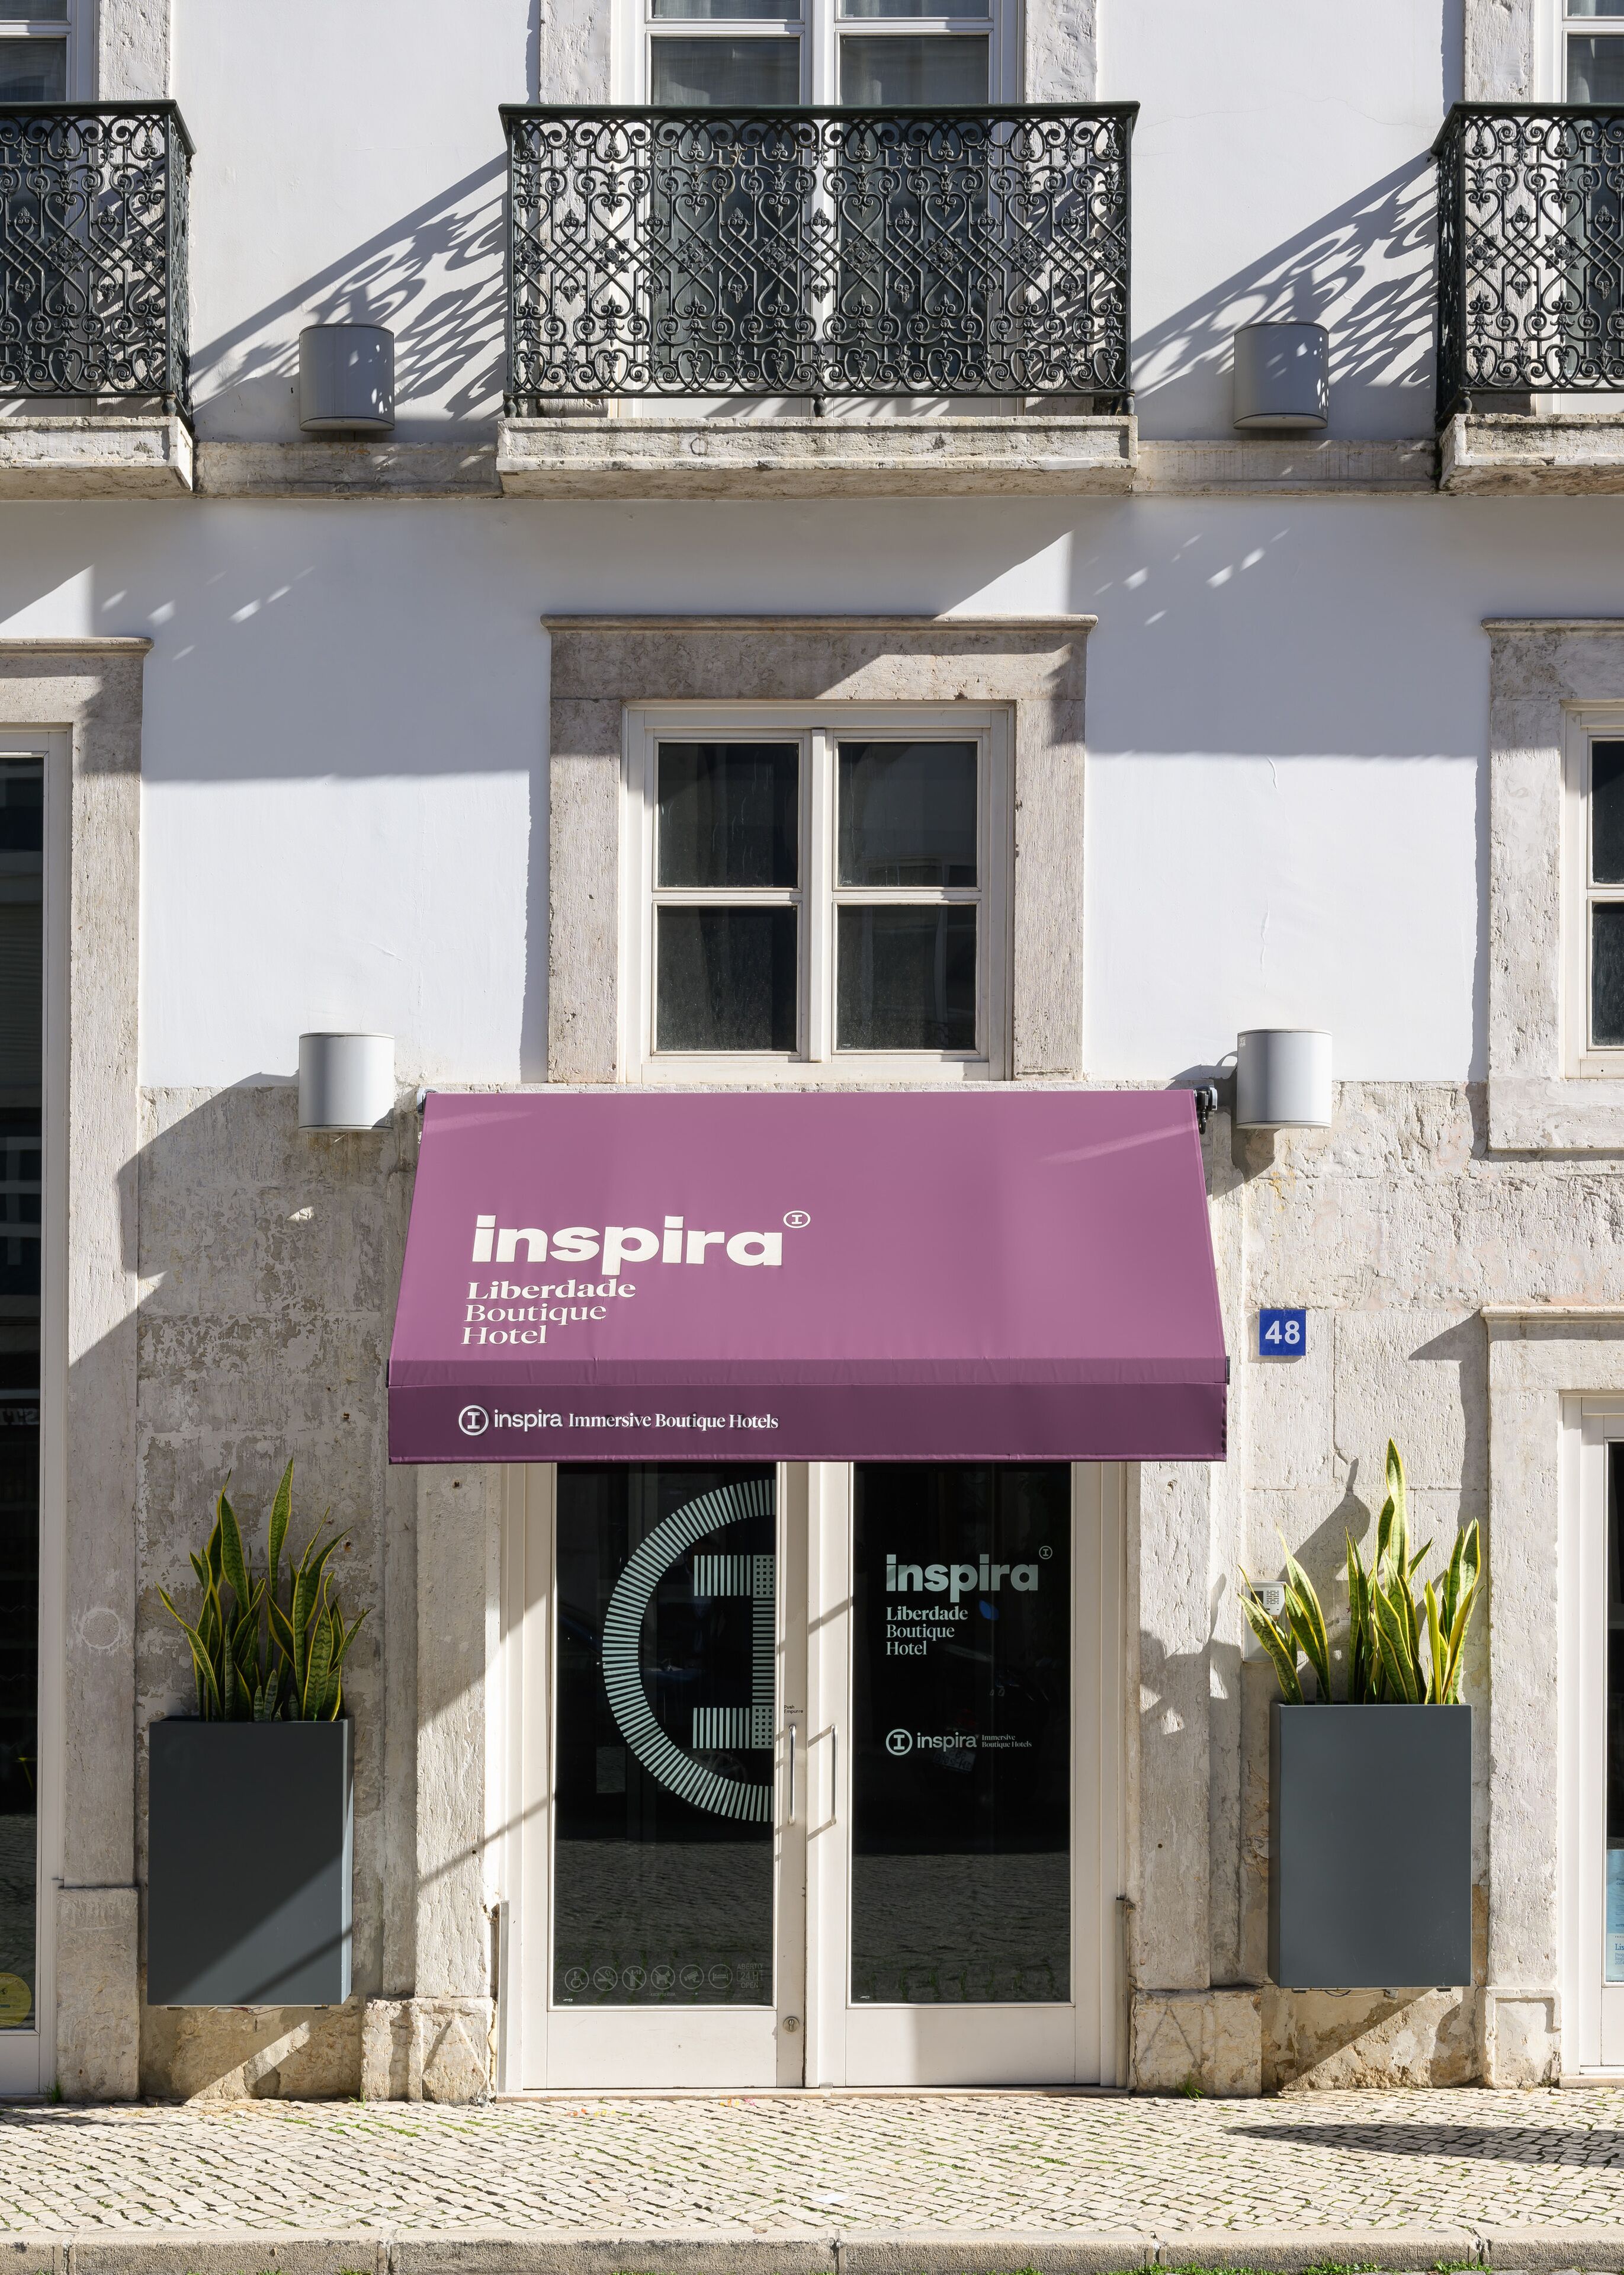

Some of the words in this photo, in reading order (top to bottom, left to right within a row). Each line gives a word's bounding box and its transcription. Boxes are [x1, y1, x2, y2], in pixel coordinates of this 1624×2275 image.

[472, 1215, 782, 1275] inspira
[466, 1279, 636, 1299] Liberdade
[464, 1303, 606, 1325] Boutique
[461, 1325, 547, 1344] Hotel
[1265, 1320, 1300, 1344] 48
[494, 1409, 563, 1431] inspira
[569, 1412, 651, 1428] Immersive
[654, 1413, 726, 1431] Boutique
[729, 1414, 779, 1429] Hotels
[886, 1554, 1038, 1603] inspira
[886, 1606, 968, 1620] Liberdade
[886, 1623, 955, 1641] Boutique
[886, 1640, 927, 1655] Hotel
[917, 1732, 977, 1752] inspira
[740, 1971, 750, 1980] 24
[752, 1971, 759, 1980] H
